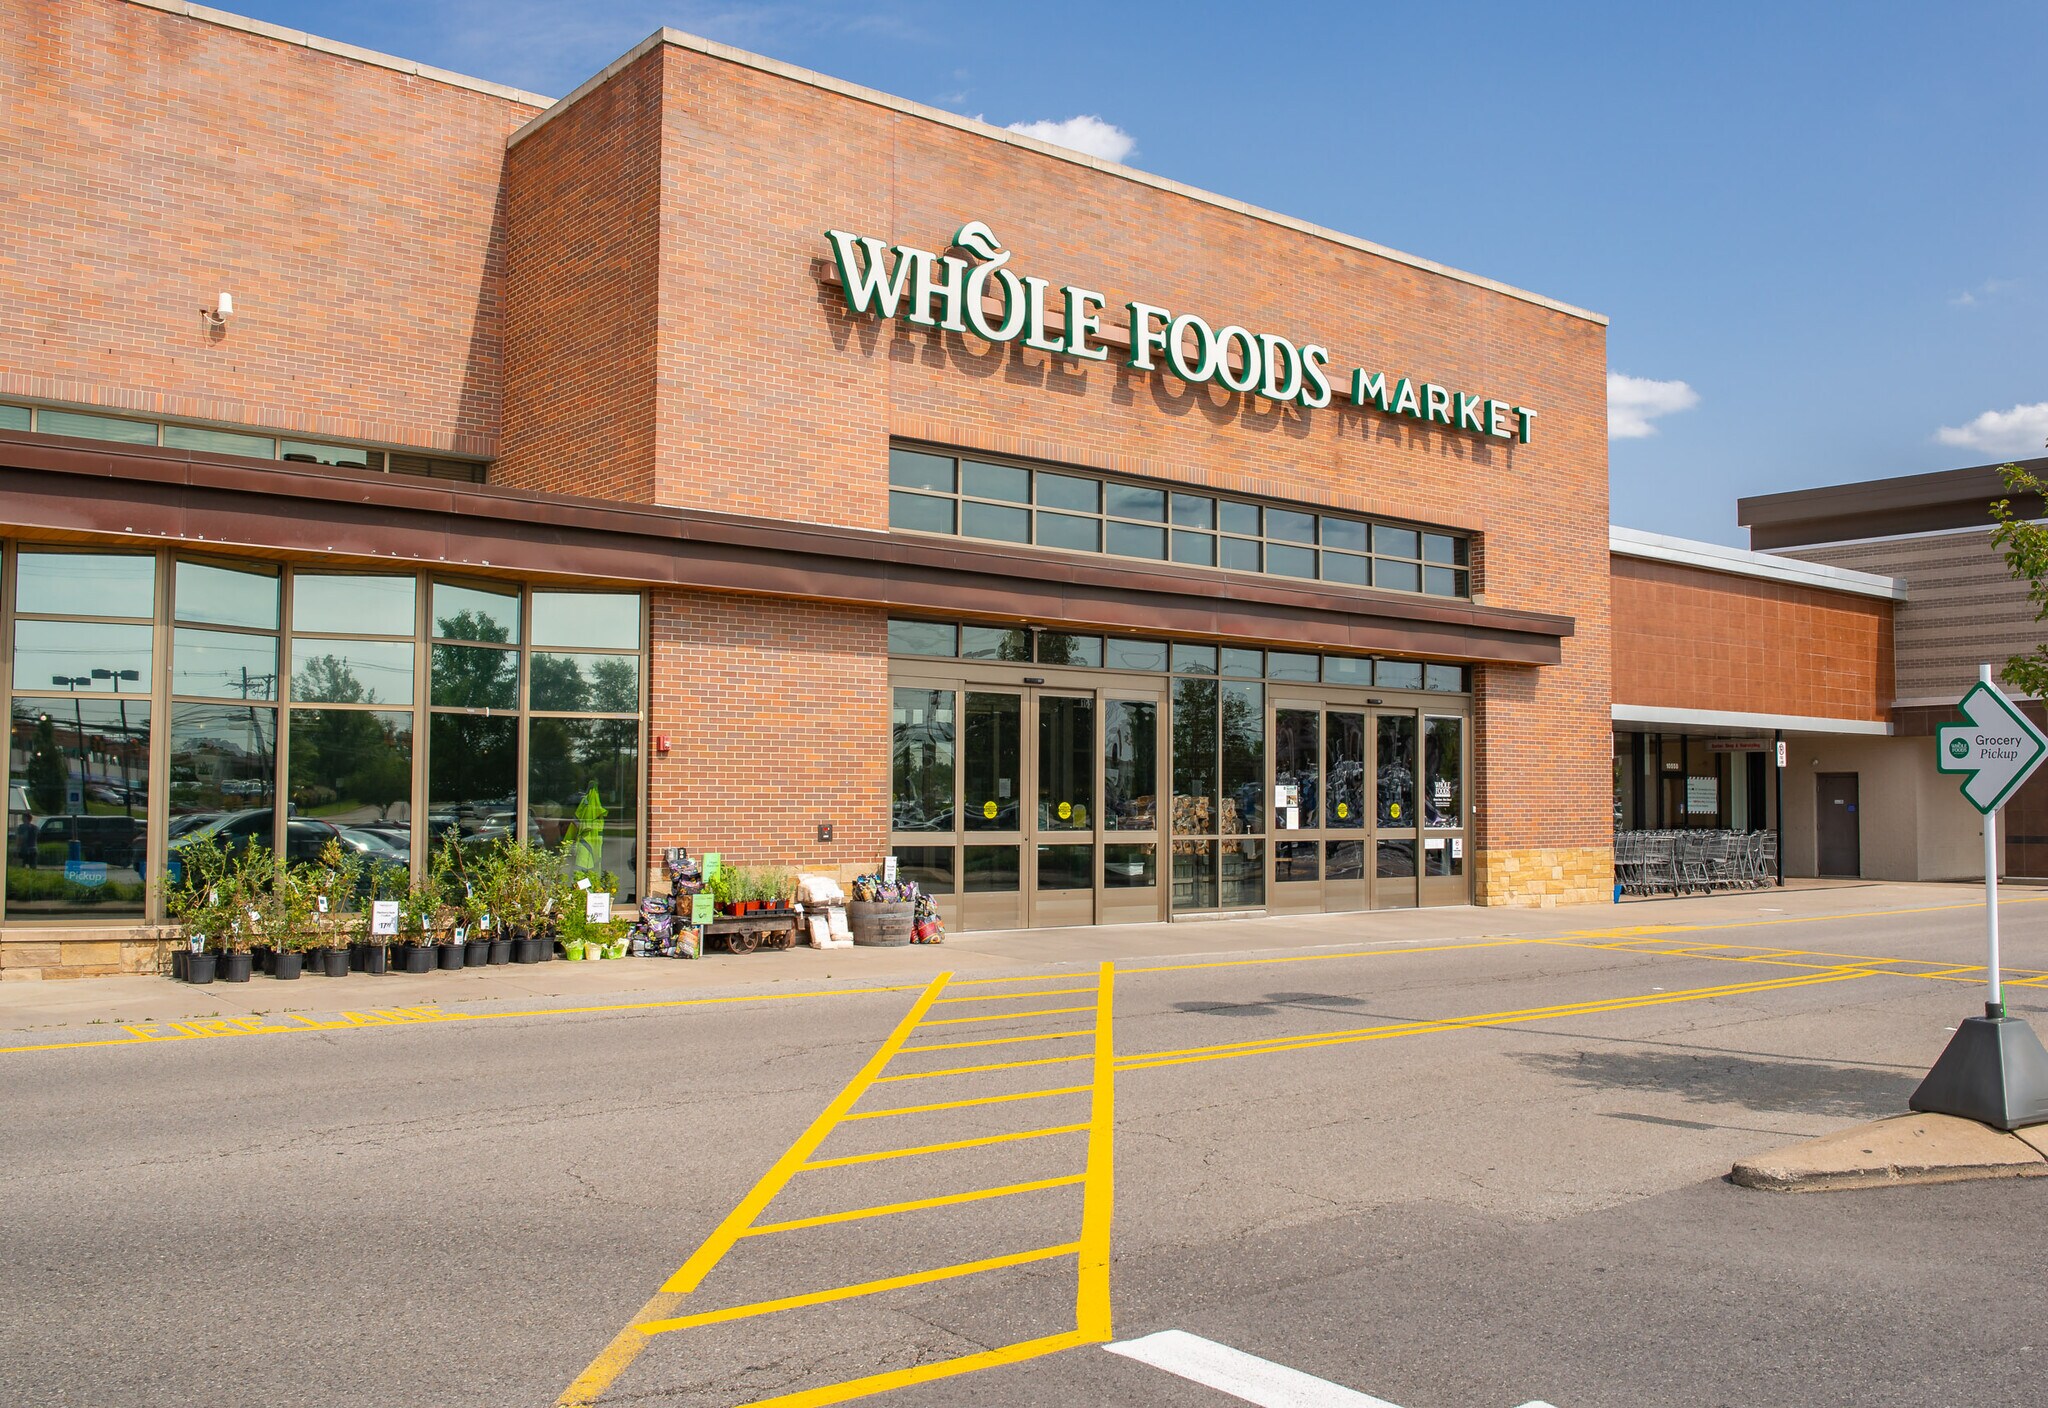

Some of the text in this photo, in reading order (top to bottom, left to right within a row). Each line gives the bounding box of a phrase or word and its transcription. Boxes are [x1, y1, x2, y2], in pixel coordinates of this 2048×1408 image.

[825, 221, 1538, 444] WHOLE FOODS MARKET
[1975, 735, 2022, 747] Grocery
[1980, 748, 2018, 761] Pickup
[69, 871, 102, 881] Pickup
[121, 1005, 467, 1040] FIRE LANE
